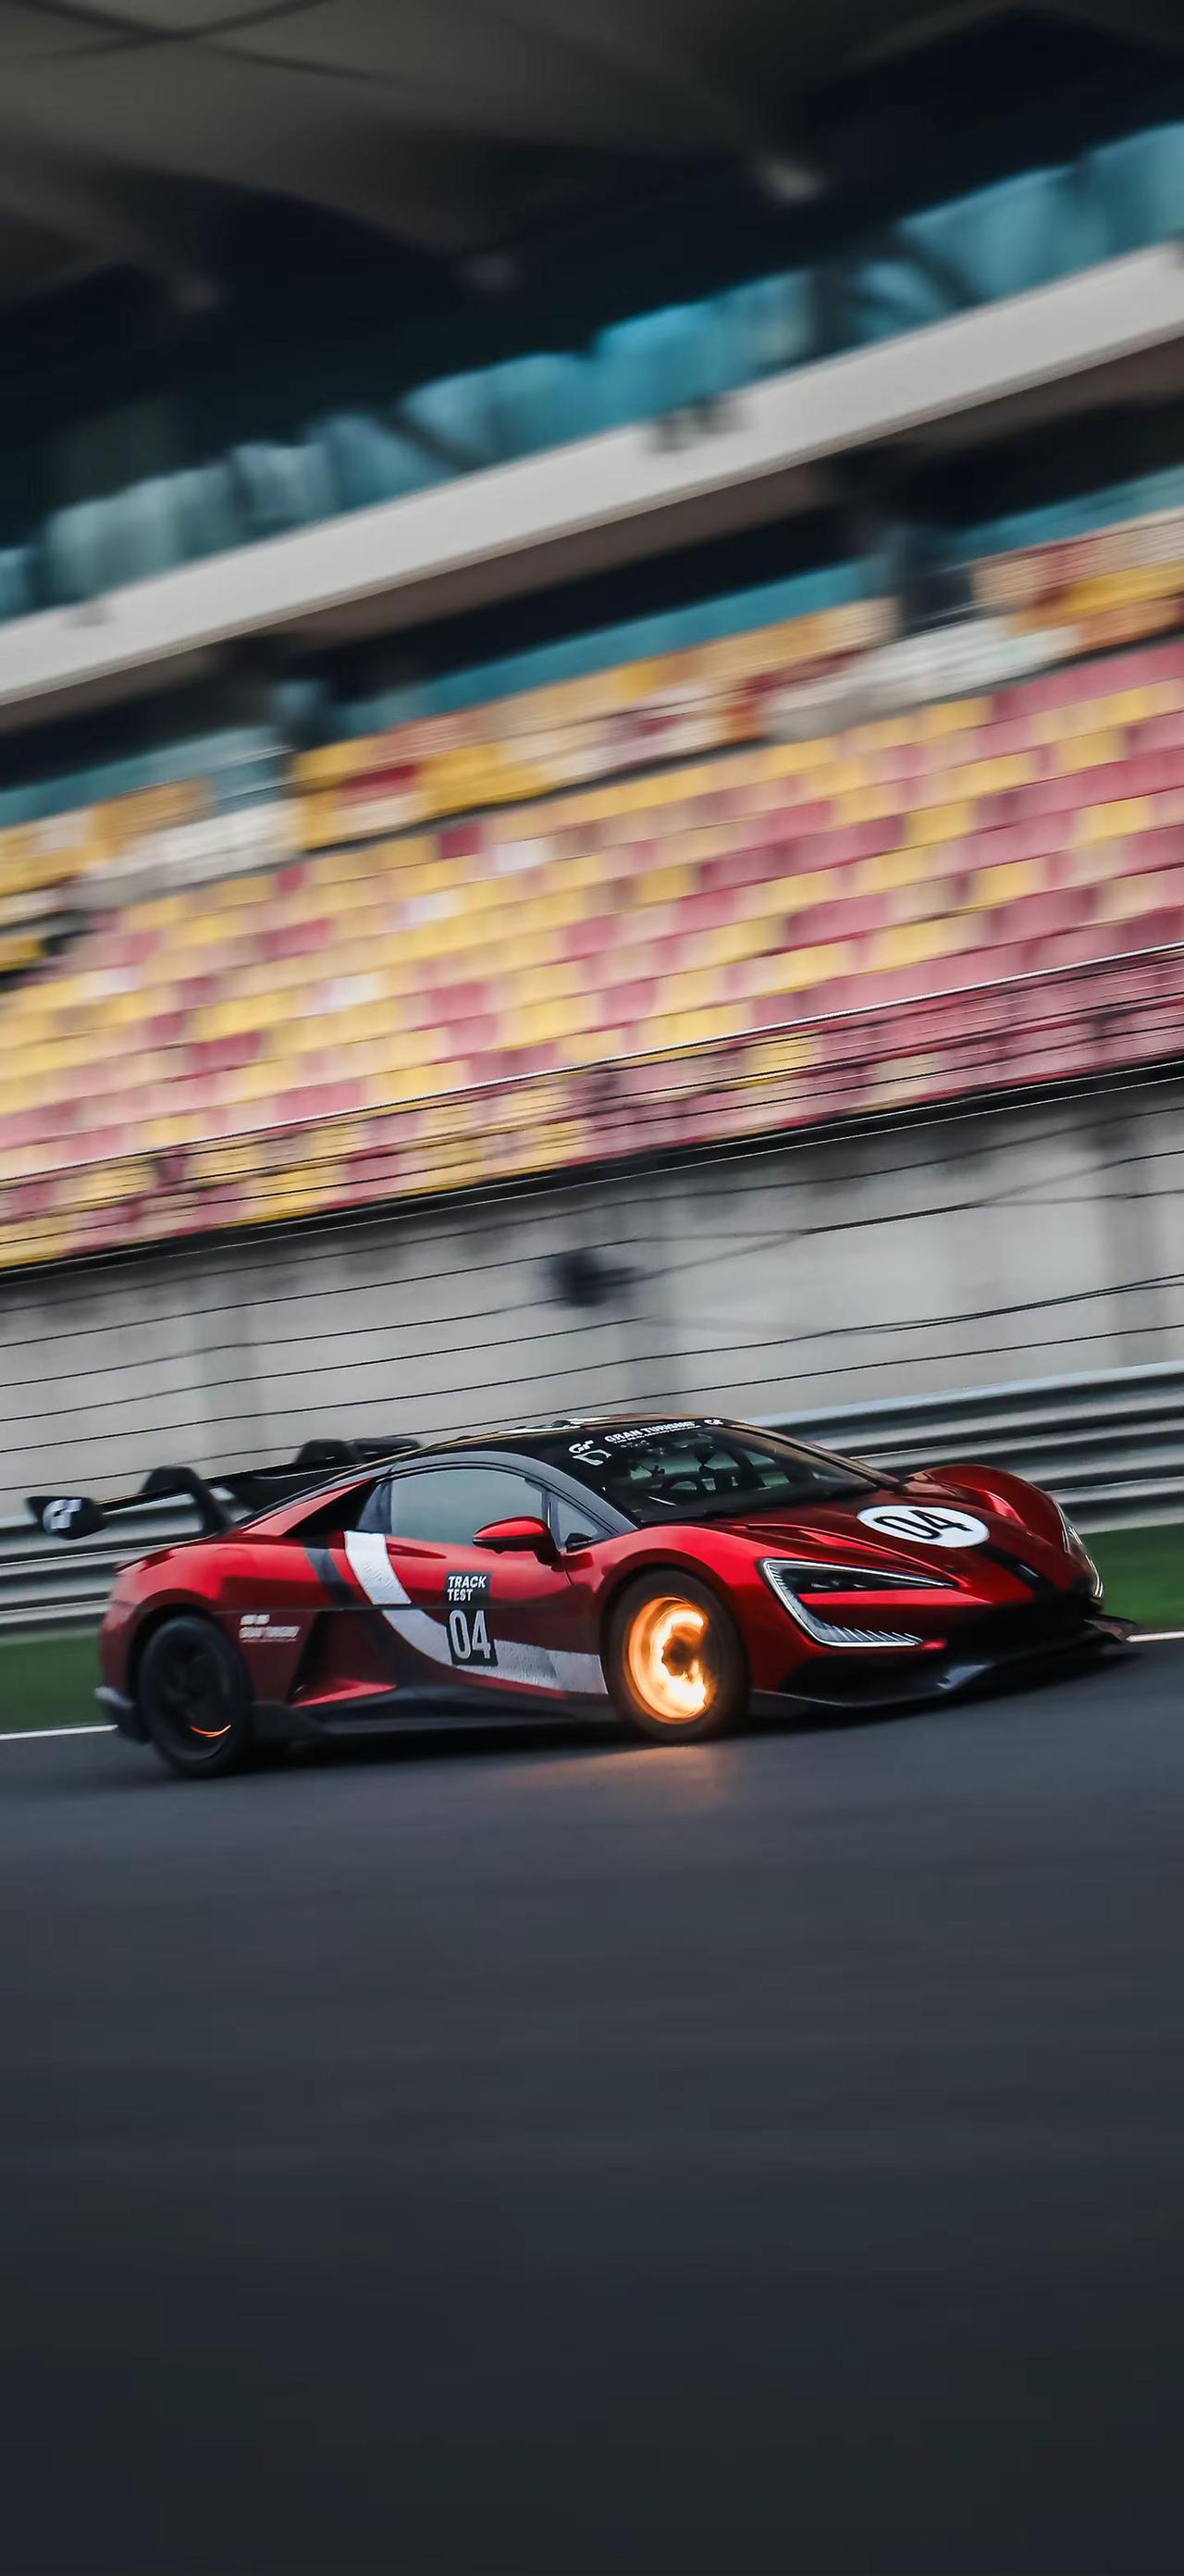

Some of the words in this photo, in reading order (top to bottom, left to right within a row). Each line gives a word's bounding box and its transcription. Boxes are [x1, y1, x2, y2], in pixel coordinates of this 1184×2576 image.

[604, 1429, 643, 1443] GRAN
[873, 1509, 974, 1540] 04
[448, 1575, 487, 1589] TRACK
[447, 1588, 474, 1602] TEST
[450, 1609, 491, 1659] 04
